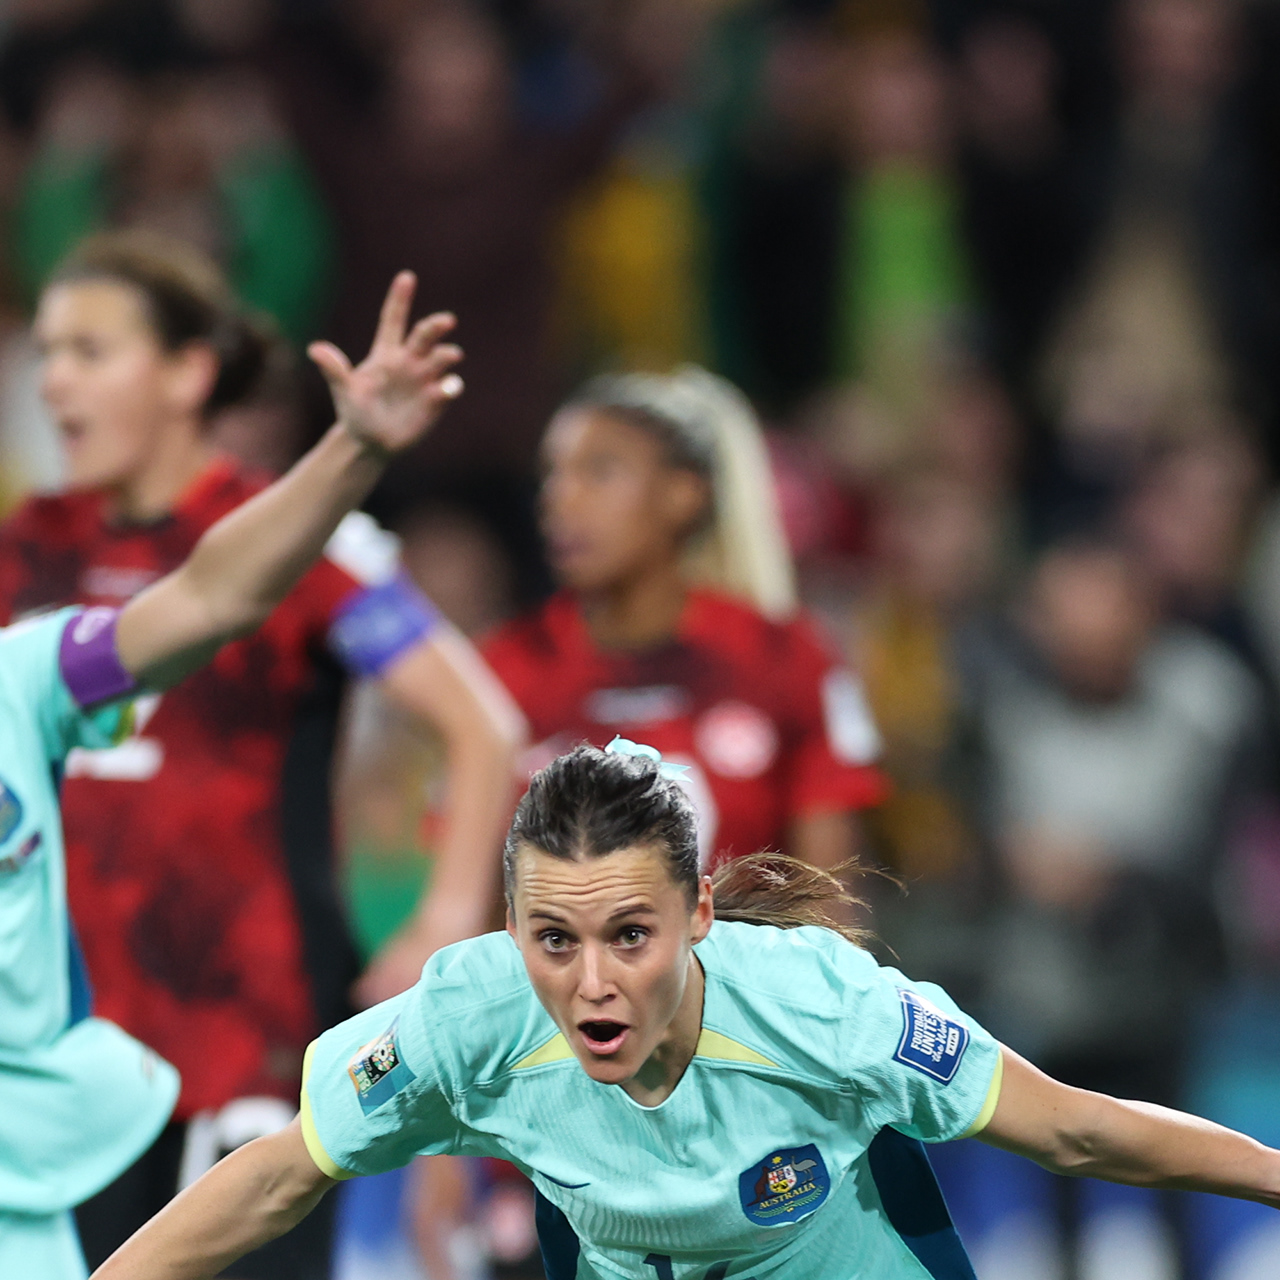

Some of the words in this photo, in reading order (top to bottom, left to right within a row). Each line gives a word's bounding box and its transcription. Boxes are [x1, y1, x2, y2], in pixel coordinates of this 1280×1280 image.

[911, 1005, 925, 1051] FOOTBALL
[920, 1010, 937, 1056] UNITES
[936, 1017, 948, 1045] Worl
[932, 1044, 945, 1062] the
[759, 1182, 817, 1210] AUSTRALIA
